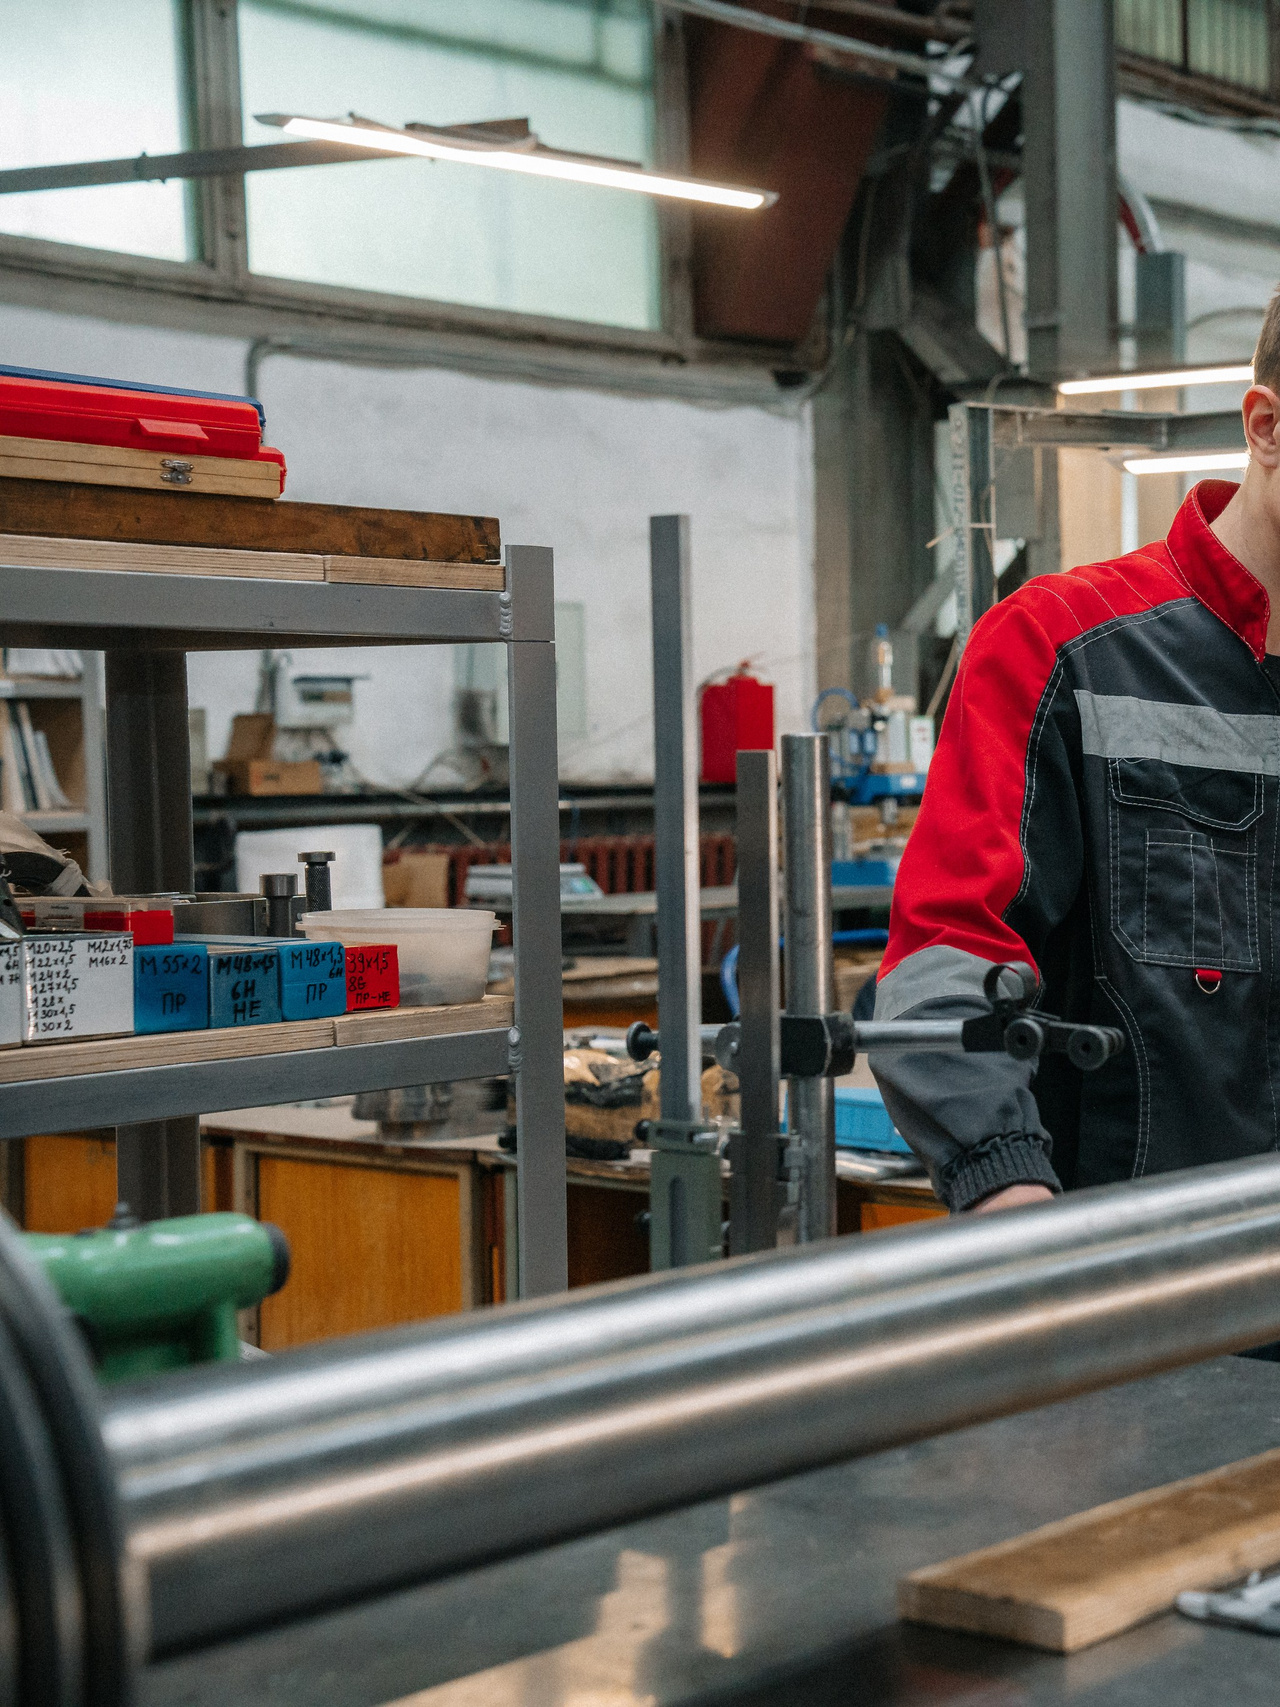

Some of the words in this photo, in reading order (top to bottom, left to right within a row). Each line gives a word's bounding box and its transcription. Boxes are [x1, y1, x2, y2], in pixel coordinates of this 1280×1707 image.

[162, 992, 186, 1015] ПР
[306, 983, 327, 1004] ПР
[233, 1000, 261, 1023] НЕ
